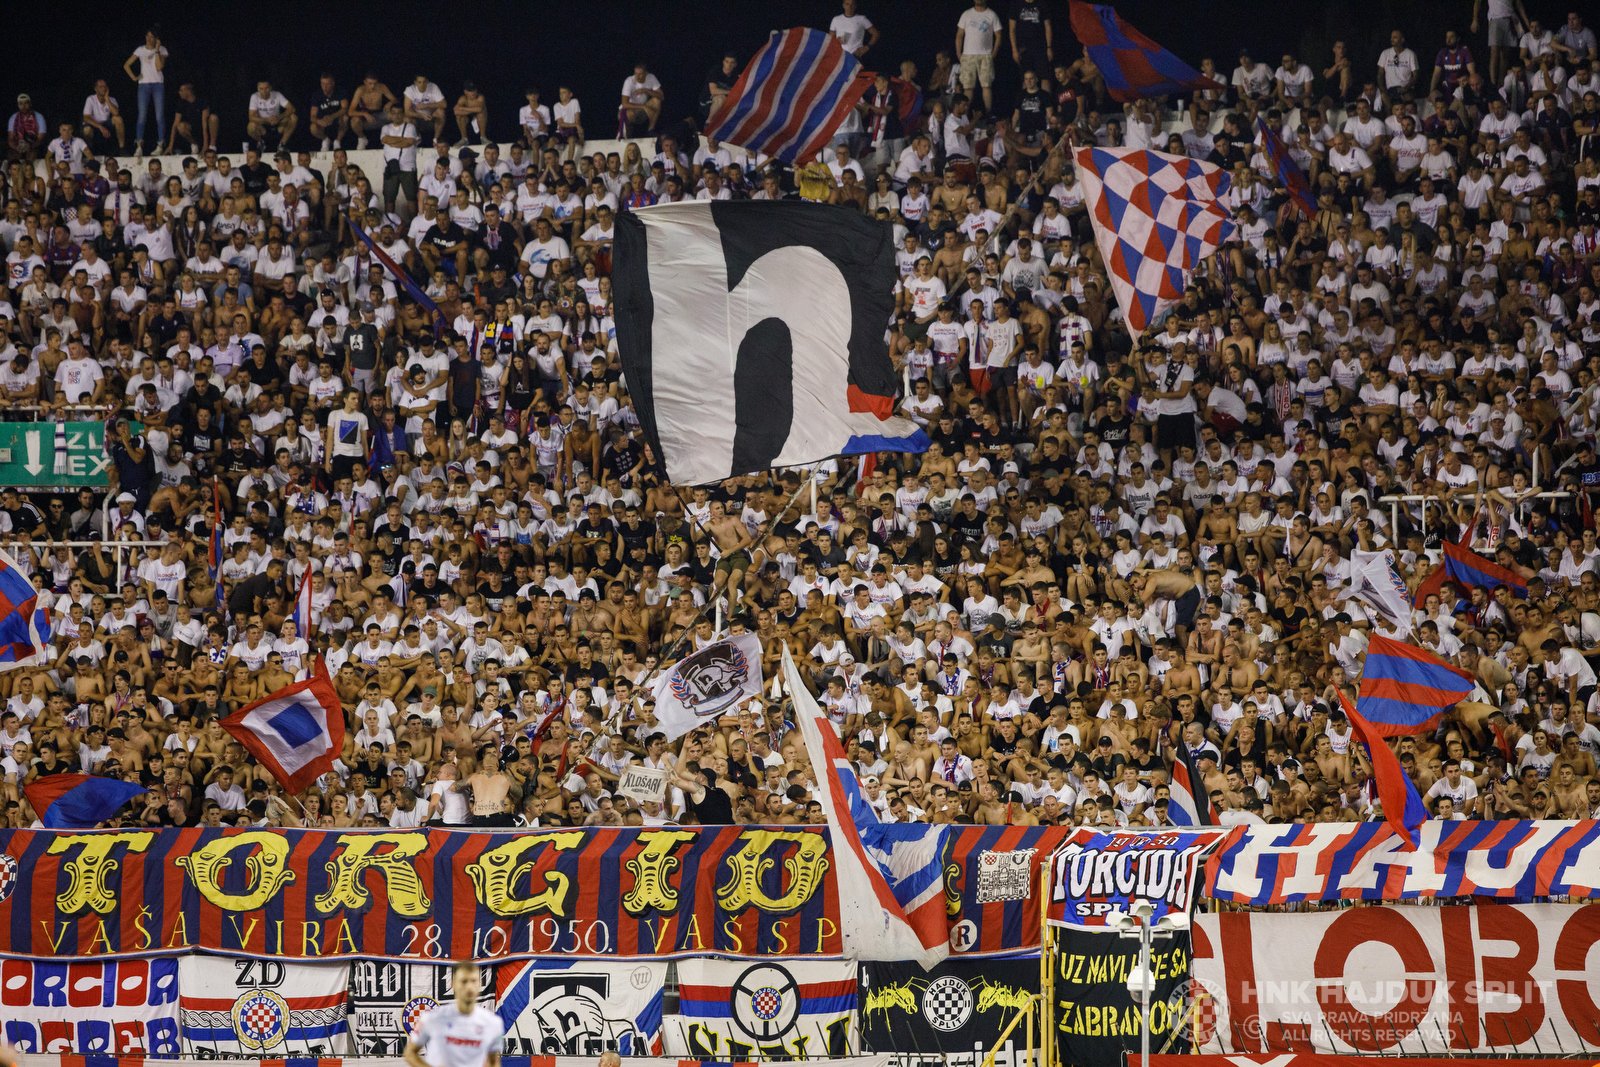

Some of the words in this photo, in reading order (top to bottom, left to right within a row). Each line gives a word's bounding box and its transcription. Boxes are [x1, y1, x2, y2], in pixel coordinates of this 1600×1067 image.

[67, 455, 112, 476] EX
[623, 772, 662, 794] KLOŠARI
[47, 830, 962, 917] TORCID
[1053, 844, 1194, 909] TORCIDA
[40, 904, 191, 954] VAŠA
[228, 914, 359, 957] VIRA
[400, 923, 449, 958] 28.
[472, 925, 508, 960] 10.
[526, 917, 613, 954] 1950.
[766, 917, 838, 954] SP
[234, 959, 286, 988] ZD
[1060, 952, 1086, 983] UZ
[1169, 947, 1188, 978] SA
[928, 978, 968, 996] HAJDUK
[243, 996, 280, 1013] HAJDUK
[405, 997, 440, 1014] HAJDU
[931, 1015, 964, 1030] SPLIT
